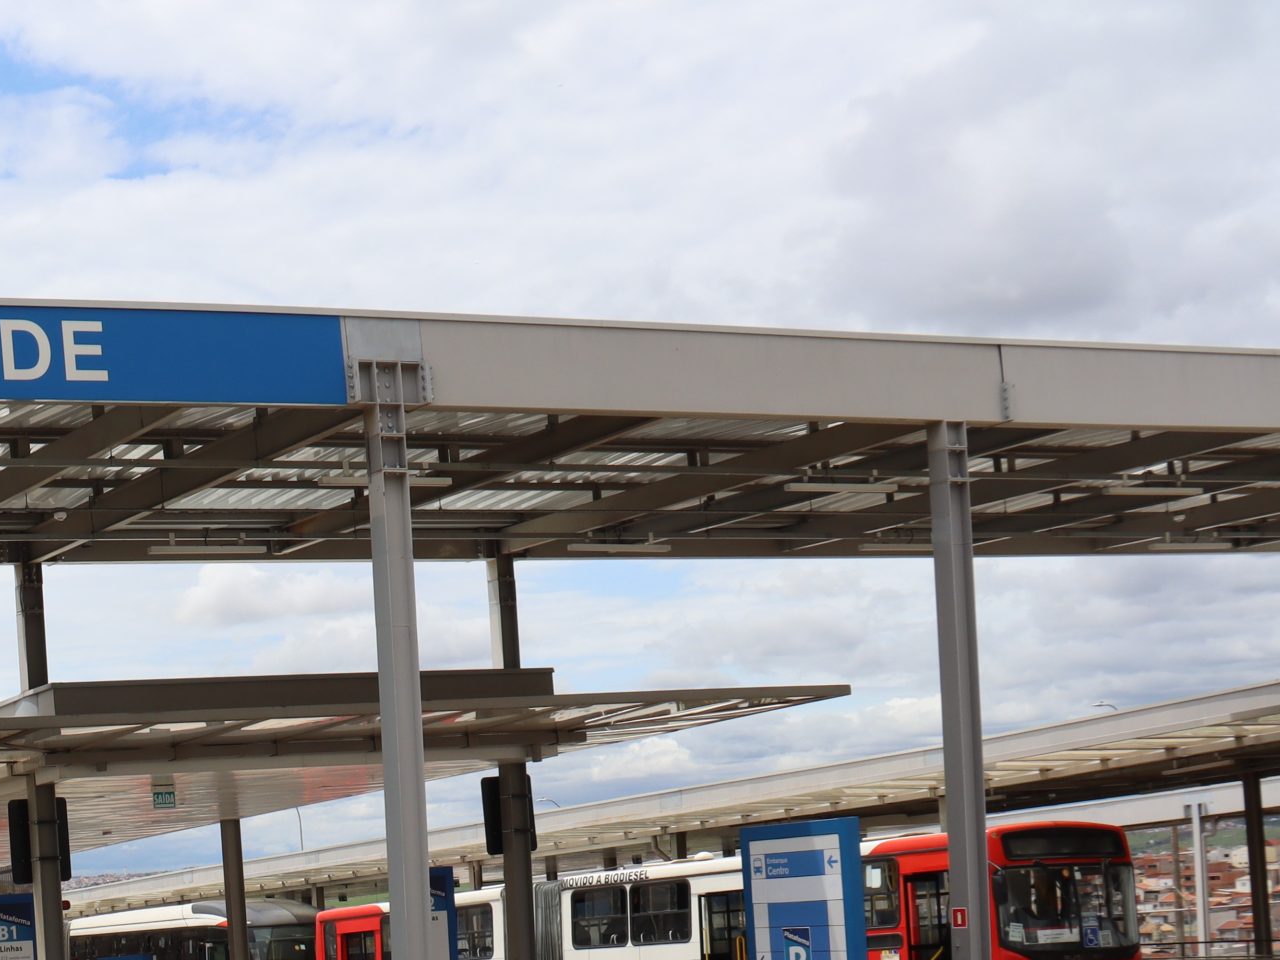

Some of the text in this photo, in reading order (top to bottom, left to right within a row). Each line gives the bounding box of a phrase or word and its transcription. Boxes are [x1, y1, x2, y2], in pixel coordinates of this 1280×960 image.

[154, 792, 175, 804] SAÍDA
[767, 865, 790, 876] Centro
[561, 869, 650, 889] MOVIDO A BIODIESEL
[0, 944, 24, 953] Linhas
